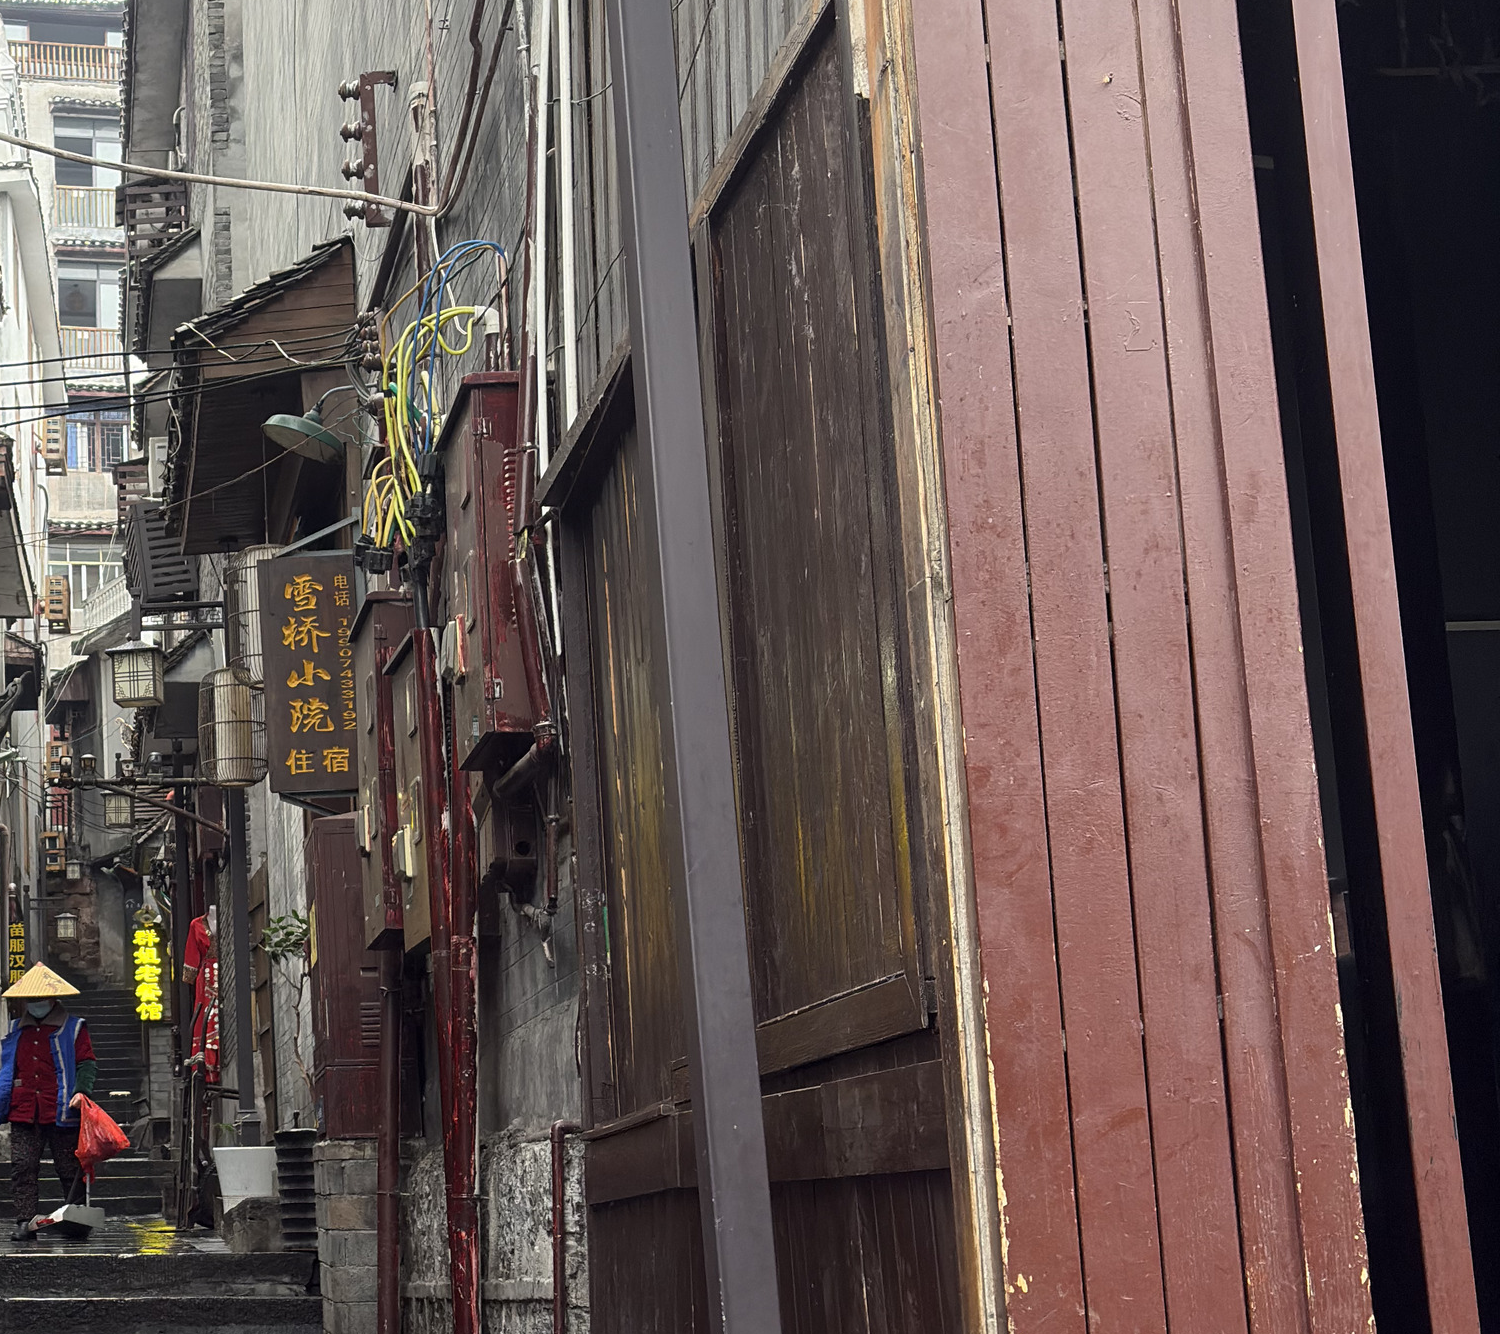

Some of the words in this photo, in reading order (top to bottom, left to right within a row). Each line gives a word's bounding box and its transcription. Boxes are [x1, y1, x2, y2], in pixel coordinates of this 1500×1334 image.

[334, 573, 349, 607] 电话
[282, 573, 334, 734] 雪桥小院
[286, 746, 350, 775] 住宿
[9, 922, 26, 984] 苗服汉服
